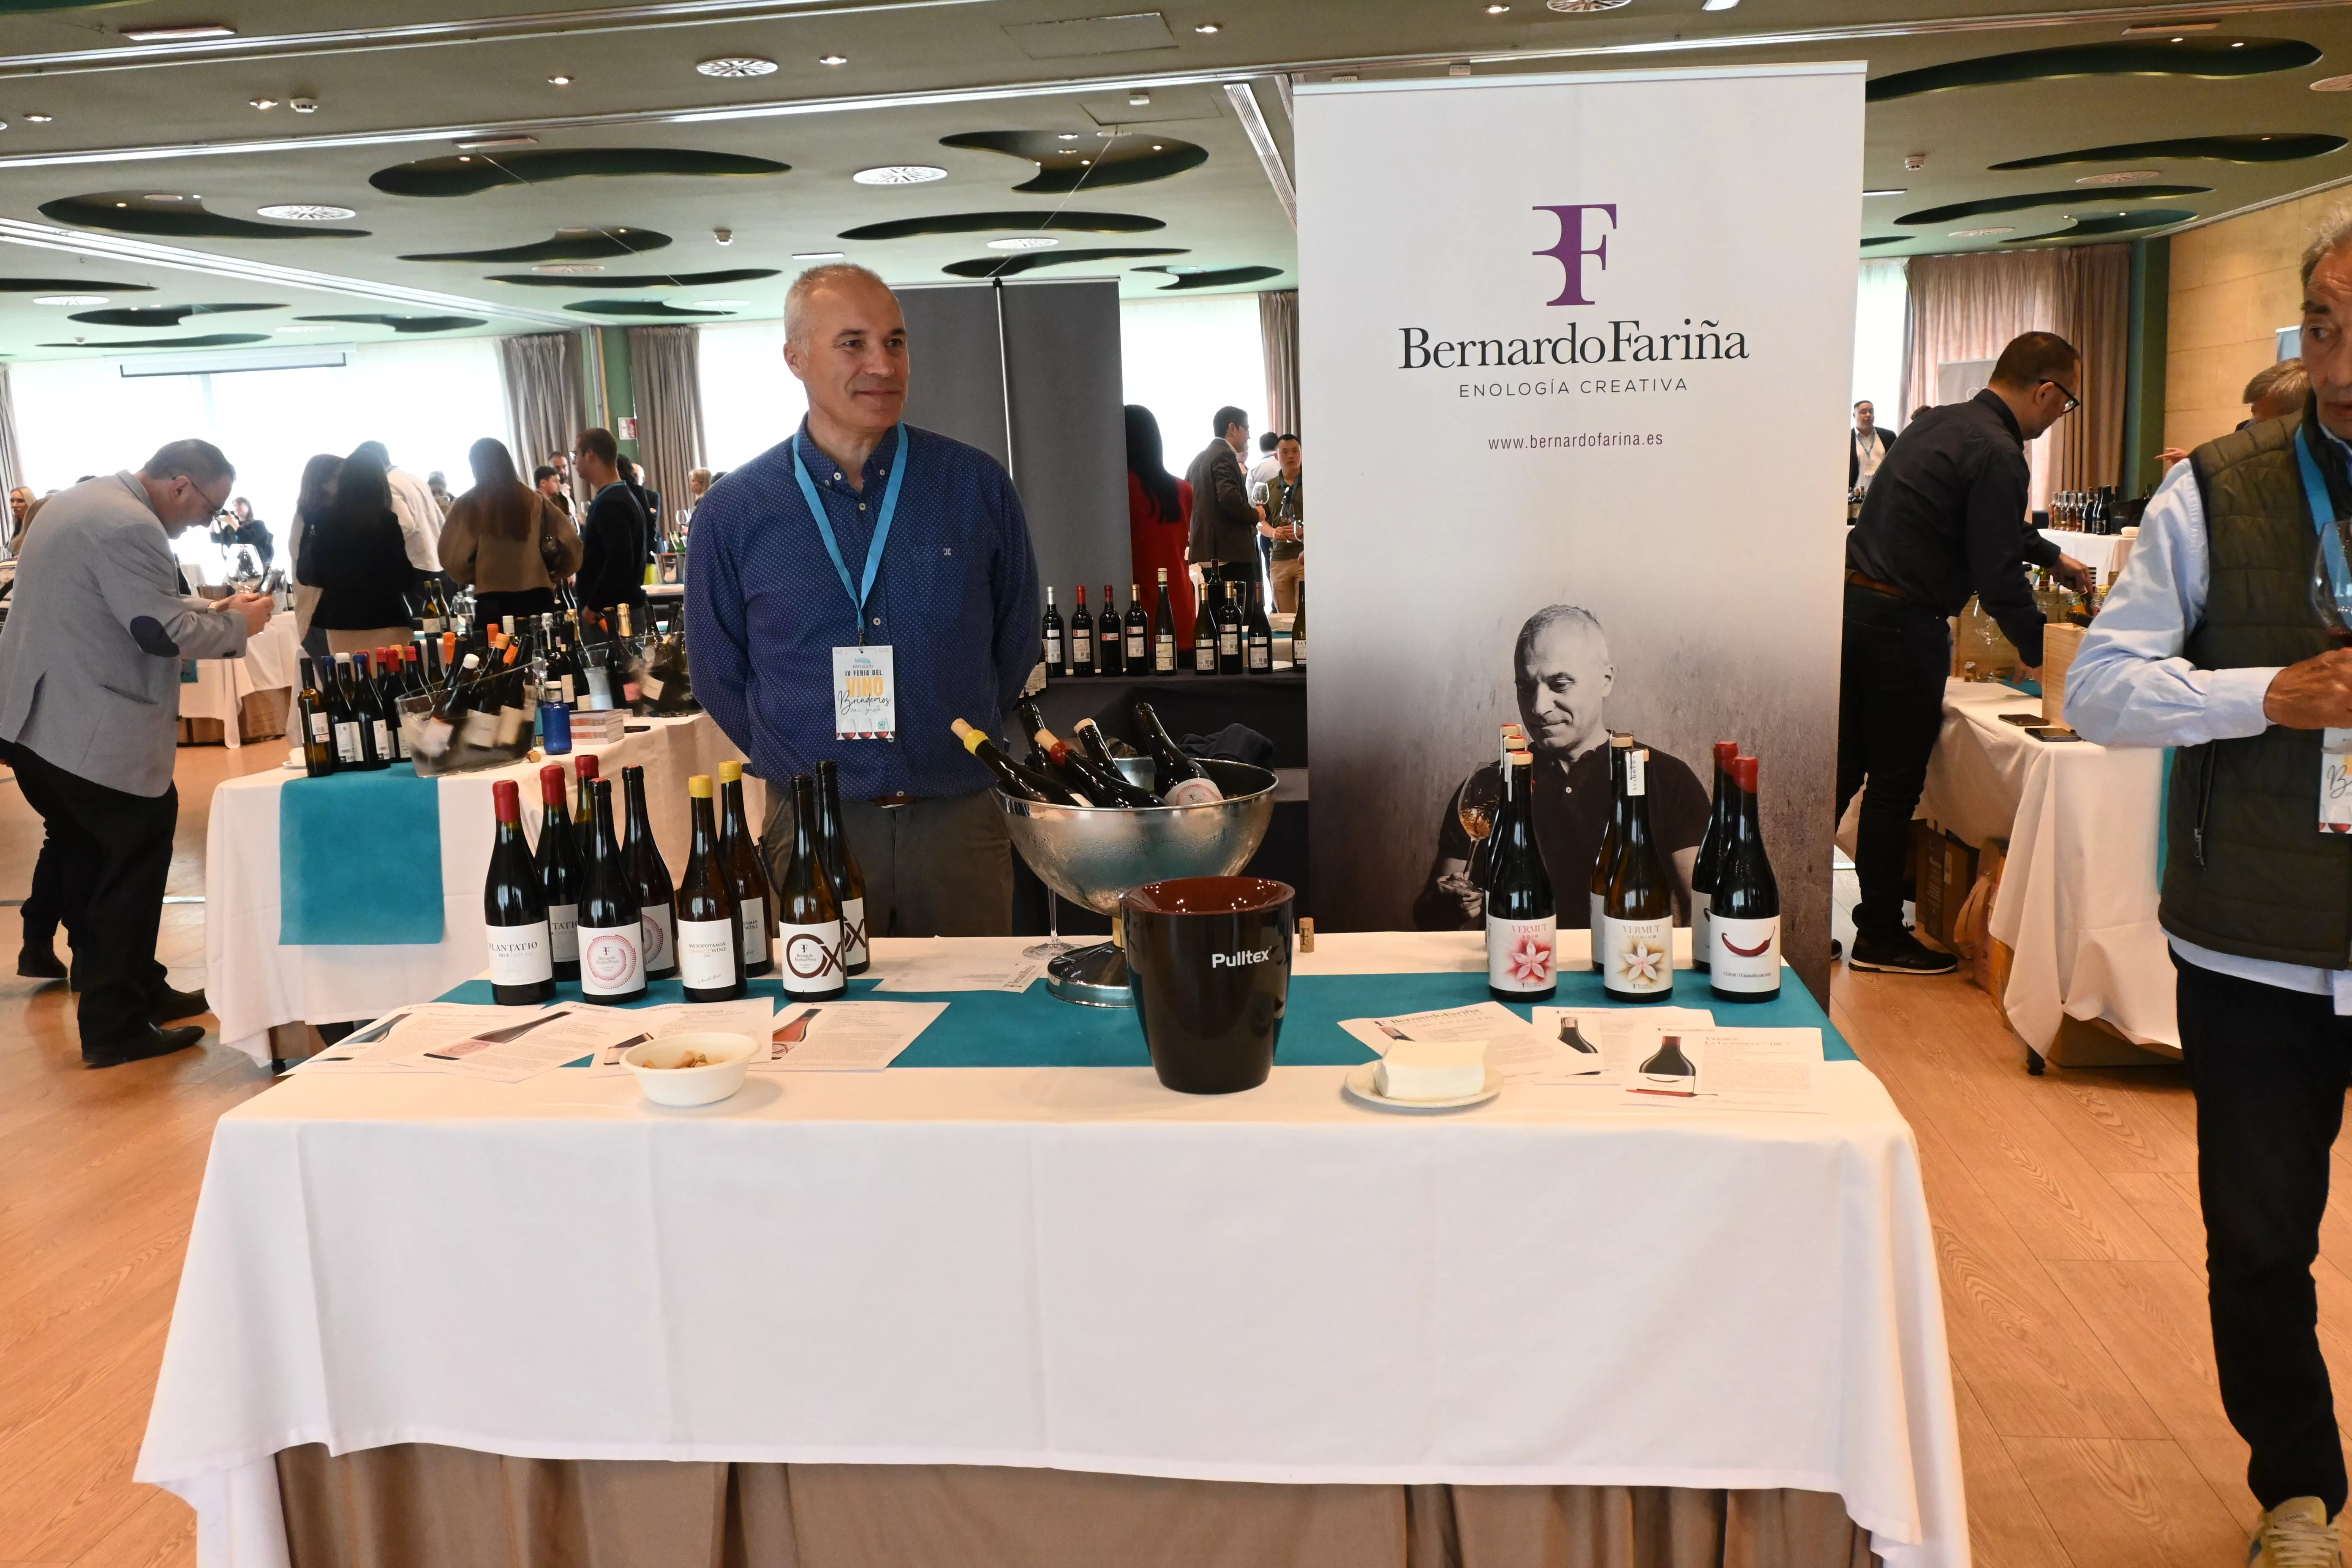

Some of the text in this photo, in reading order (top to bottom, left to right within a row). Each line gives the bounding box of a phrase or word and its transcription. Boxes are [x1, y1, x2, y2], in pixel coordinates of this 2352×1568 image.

[1398, 318, 1750, 369] BernardoFariña
[1460, 378, 1688, 398] ENOLOGÍA CREATIVA
[1488, 431, 1663, 450] www.bernardofarina.es
[846, 676, 884, 697] VINO
[837, 689, 892, 715] Brindemos
[1511, 924, 1549, 933] VERMUT
[1623, 925, 1661, 934] VERMUT
[488, 942, 538, 951] PLANTATIO
[1212, 949, 1269, 968] Pulltex
